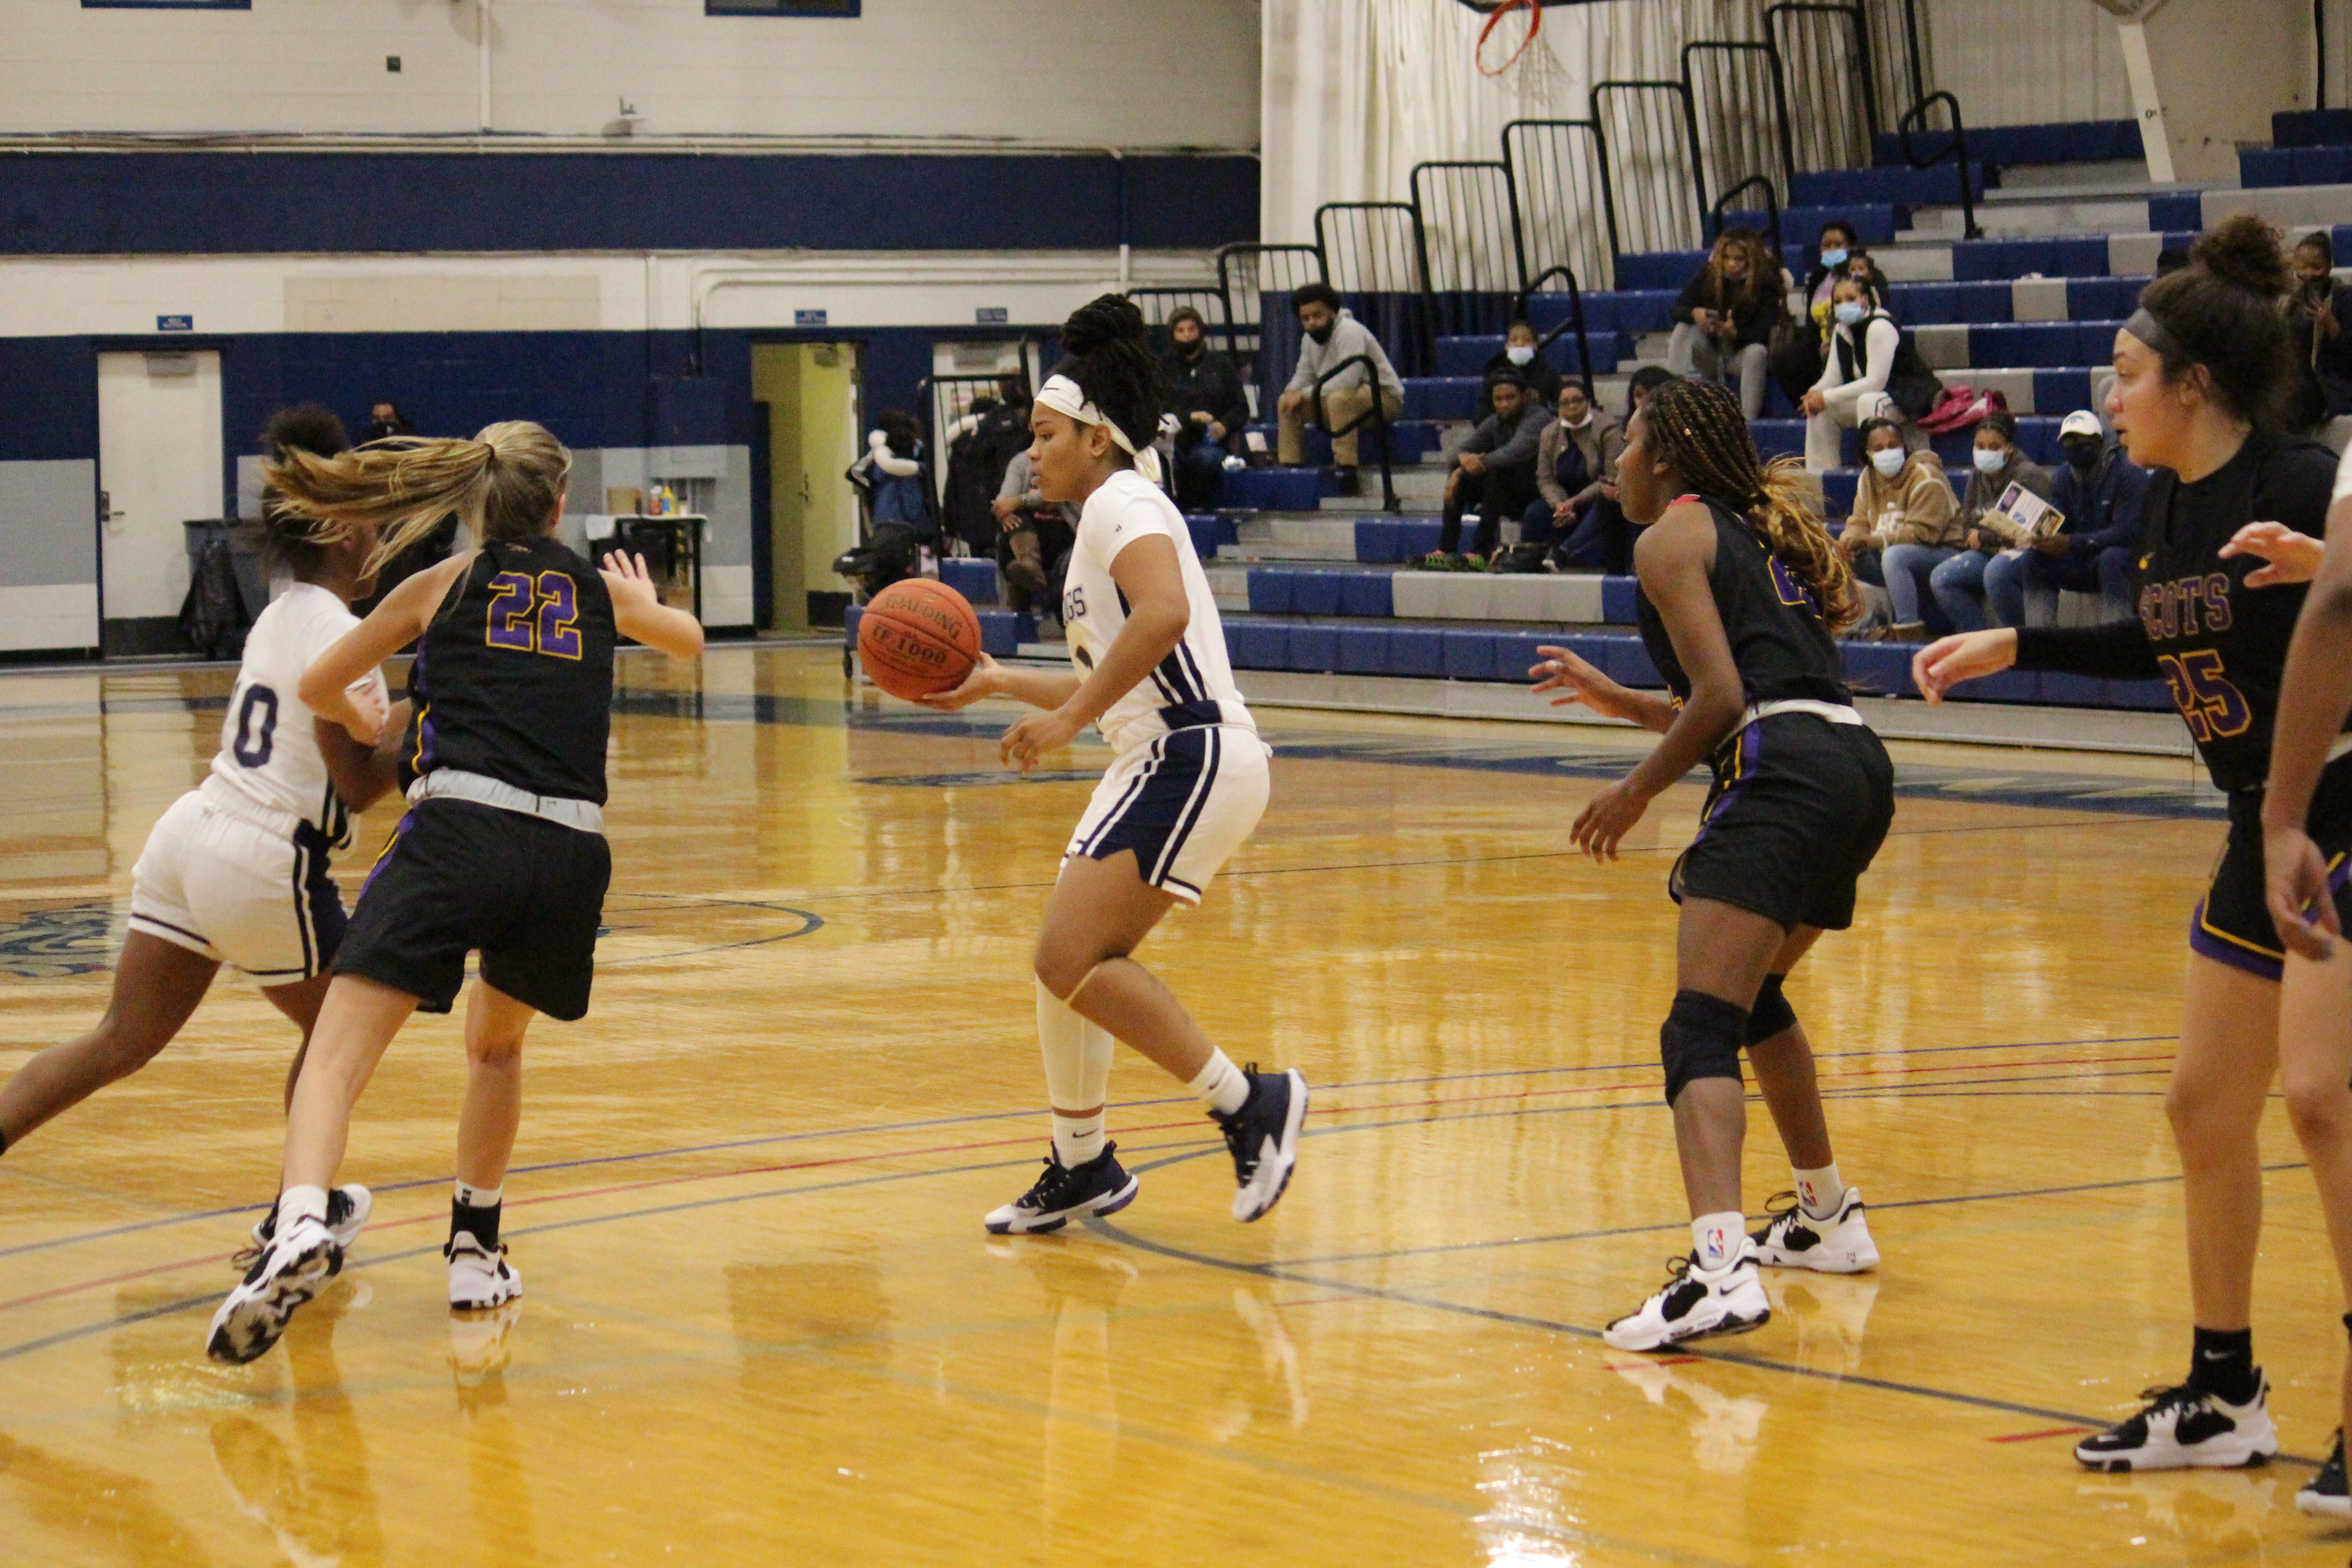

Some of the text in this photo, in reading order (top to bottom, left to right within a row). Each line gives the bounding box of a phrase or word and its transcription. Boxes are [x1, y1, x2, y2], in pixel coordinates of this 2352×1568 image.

[485, 570, 583, 661] 22
[898, 637, 947, 665] 1000
[234, 684, 279, 768] 0
[2157, 648, 2252, 743] 25
